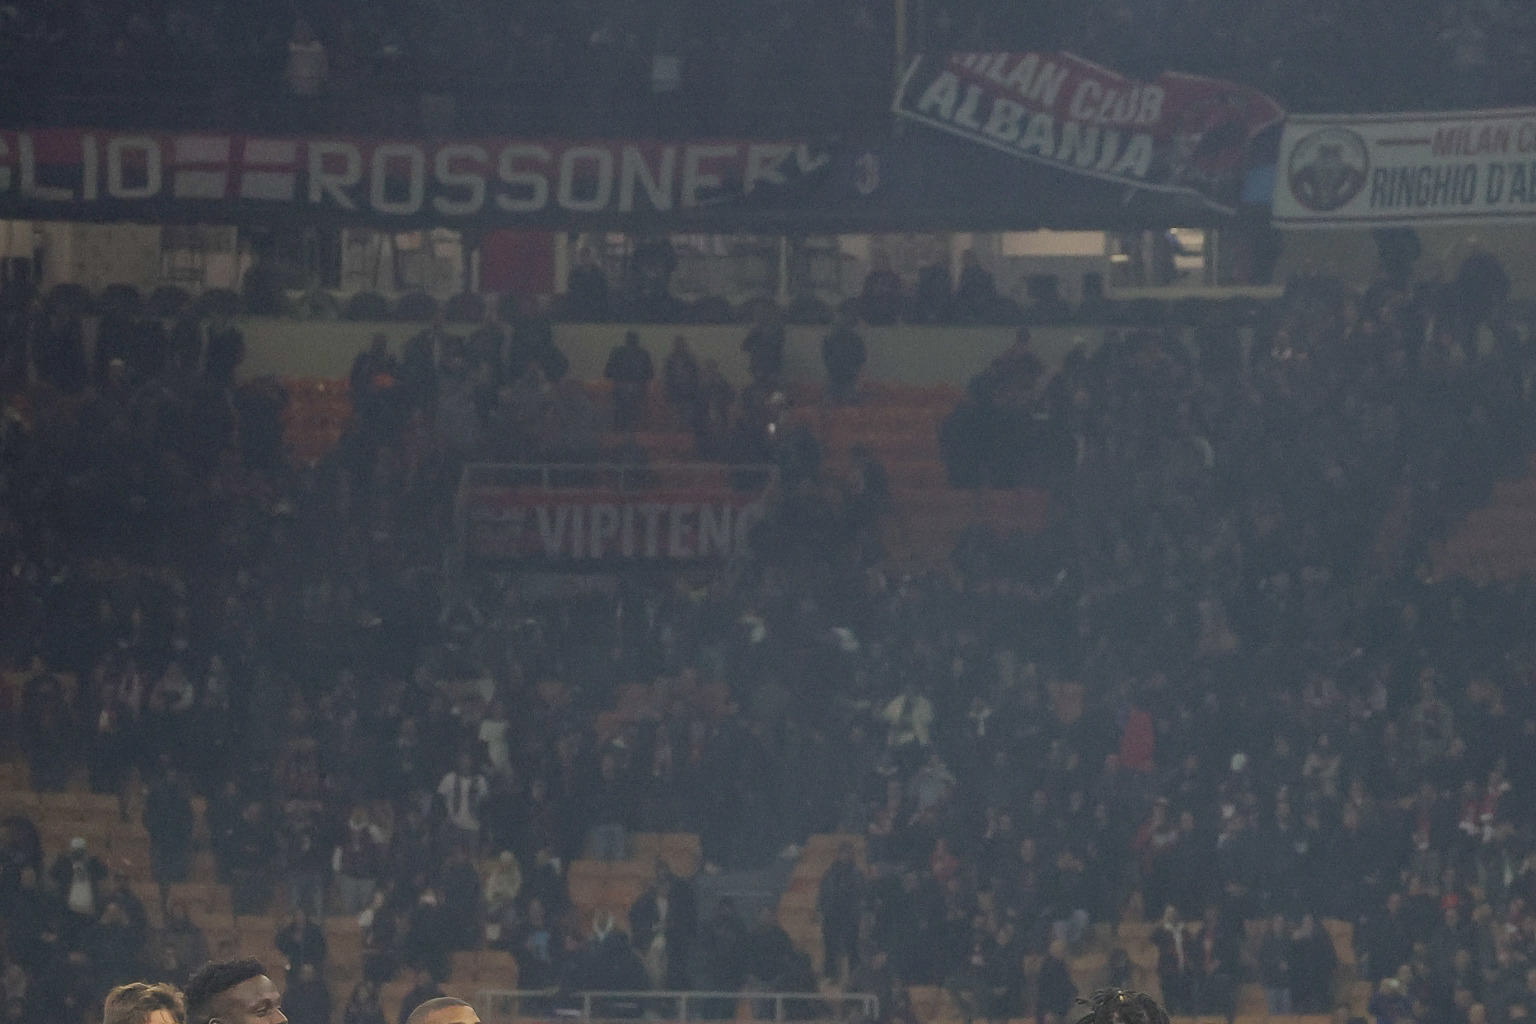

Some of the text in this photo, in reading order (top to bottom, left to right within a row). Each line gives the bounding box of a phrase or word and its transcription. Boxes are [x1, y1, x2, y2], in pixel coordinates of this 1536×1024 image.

[917, 69, 1154, 179] ALBANIA
[1431, 126, 1512, 157] MILAN
[0, 133, 163, 200] LIO
[1369, 160, 1477, 208] RINGHIO
